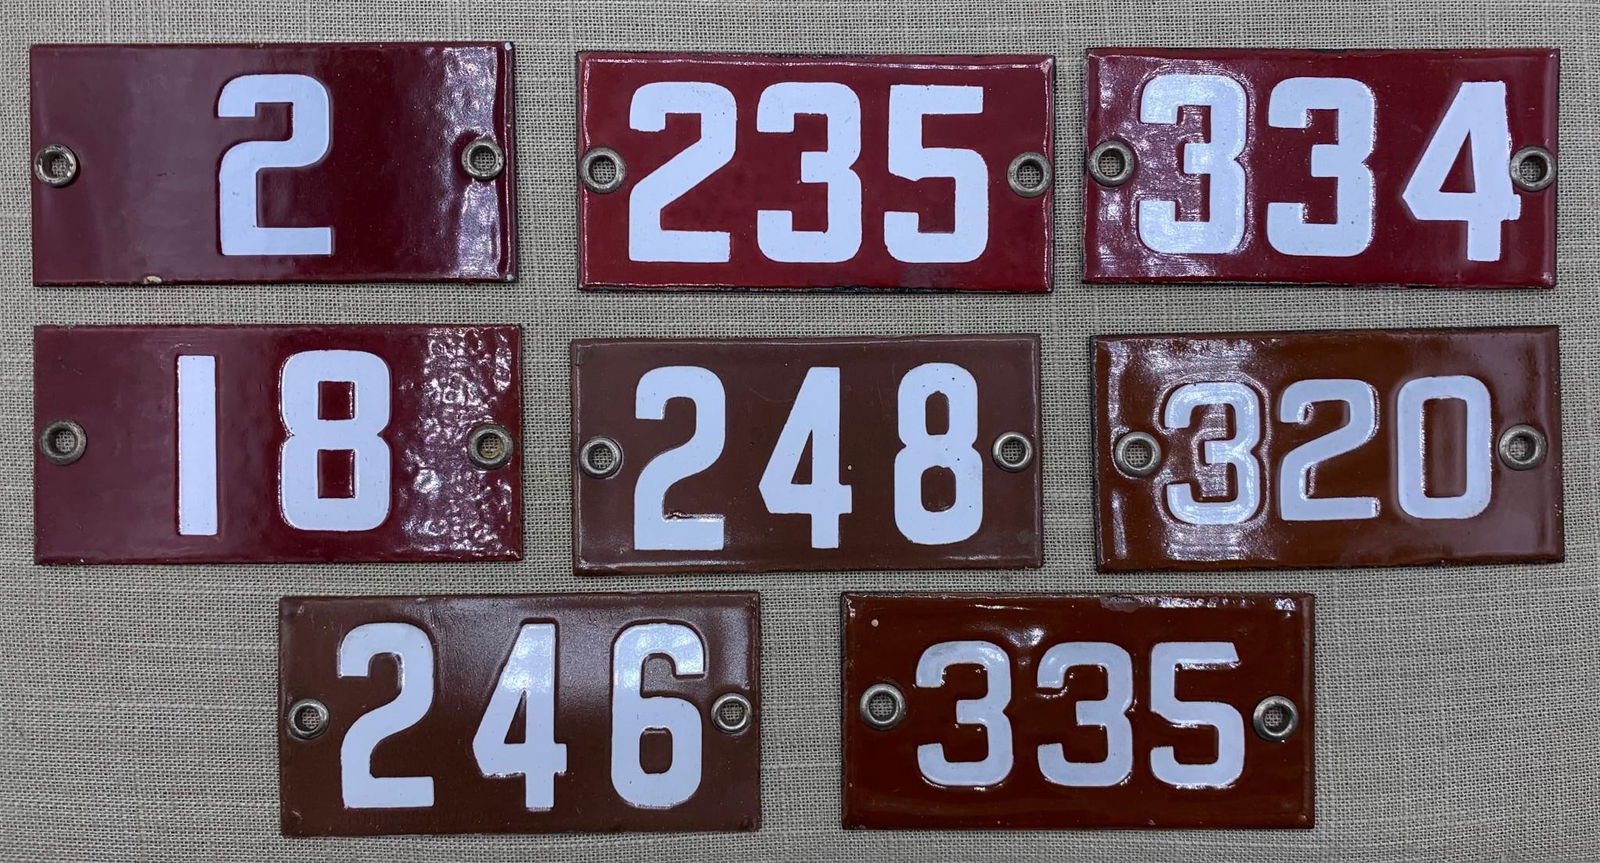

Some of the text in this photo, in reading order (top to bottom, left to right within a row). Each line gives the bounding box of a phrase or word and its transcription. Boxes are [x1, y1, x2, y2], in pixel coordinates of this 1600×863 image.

[218, 74, 333, 256] 2
[628, 81, 990, 264] 235
[1137, 73, 1521, 262] 334
[177, 350, 391, 536] 18
[634, 363, 984, 551] 248
[1164, 376, 1493, 527] 320
[338, 621, 707, 811] 246
[914, 641, 1246, 788] 335
